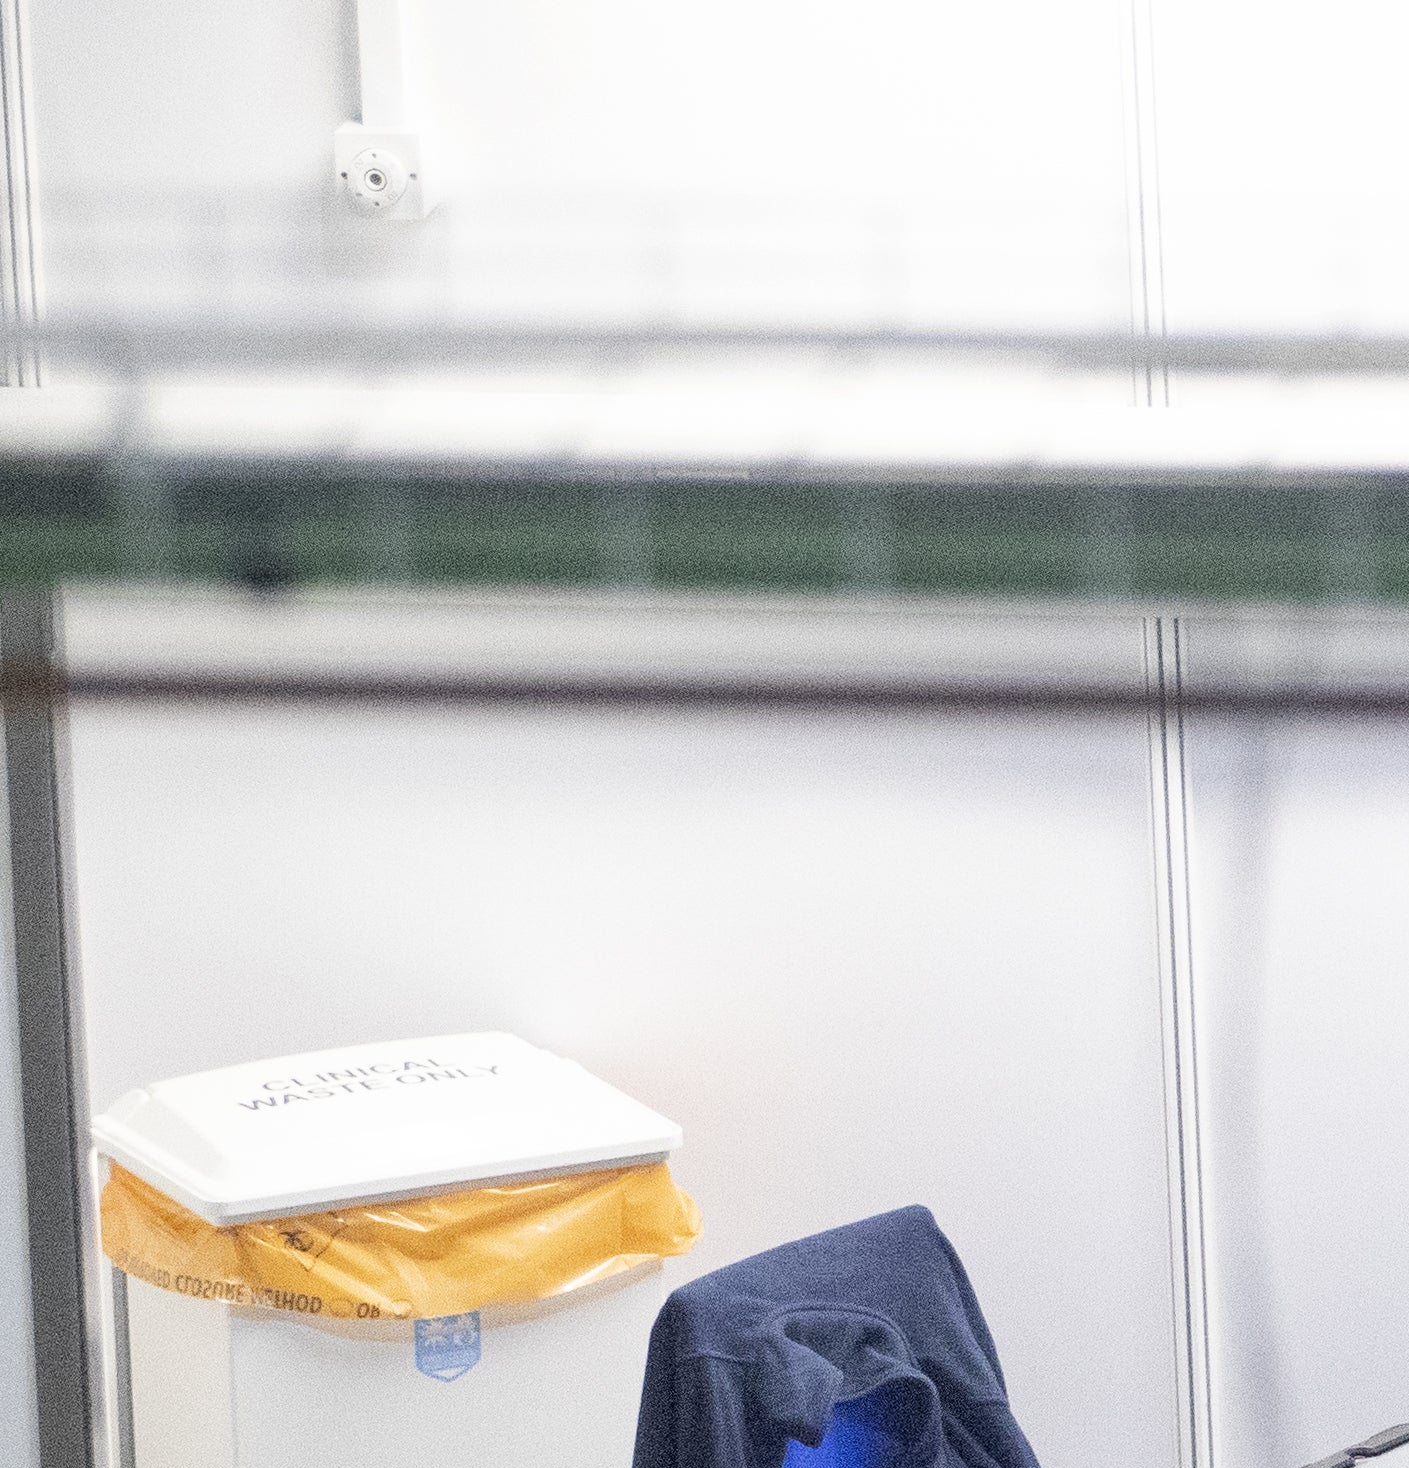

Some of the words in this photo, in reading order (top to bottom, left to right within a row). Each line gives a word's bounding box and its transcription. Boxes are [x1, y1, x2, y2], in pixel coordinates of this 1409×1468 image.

[239, 1077, 392, 1112] WASTE
[395, 1065, 499, 1085] ONLY
[261, 1058, 455, 1092] CLINICAL
